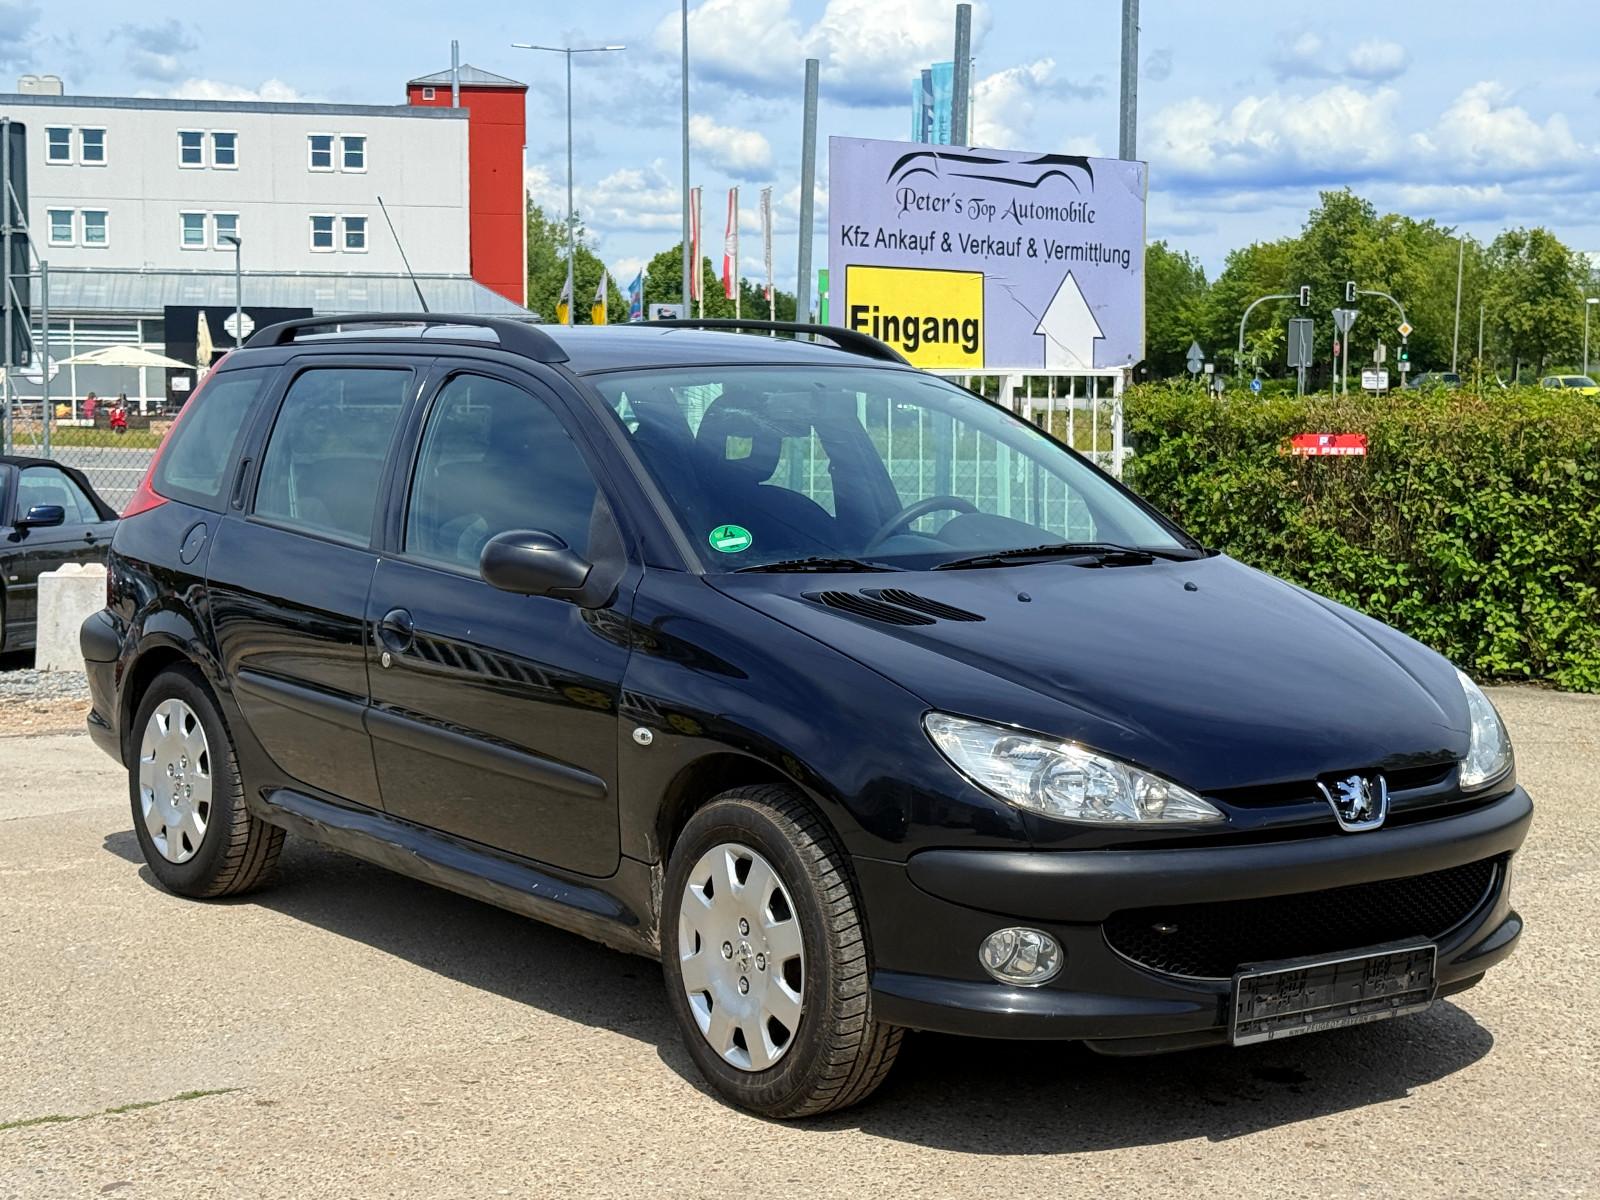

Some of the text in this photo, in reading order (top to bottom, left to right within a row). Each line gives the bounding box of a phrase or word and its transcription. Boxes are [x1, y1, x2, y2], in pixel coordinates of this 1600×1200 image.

[967, 198, 997, 223] Top
[1000, 197, 1097, 226] Automobile
[841, 224, 1131, 269] Kfz Ankauf & Verkauf & Vermittlung
[850, 304, 979, 354] Eingang
